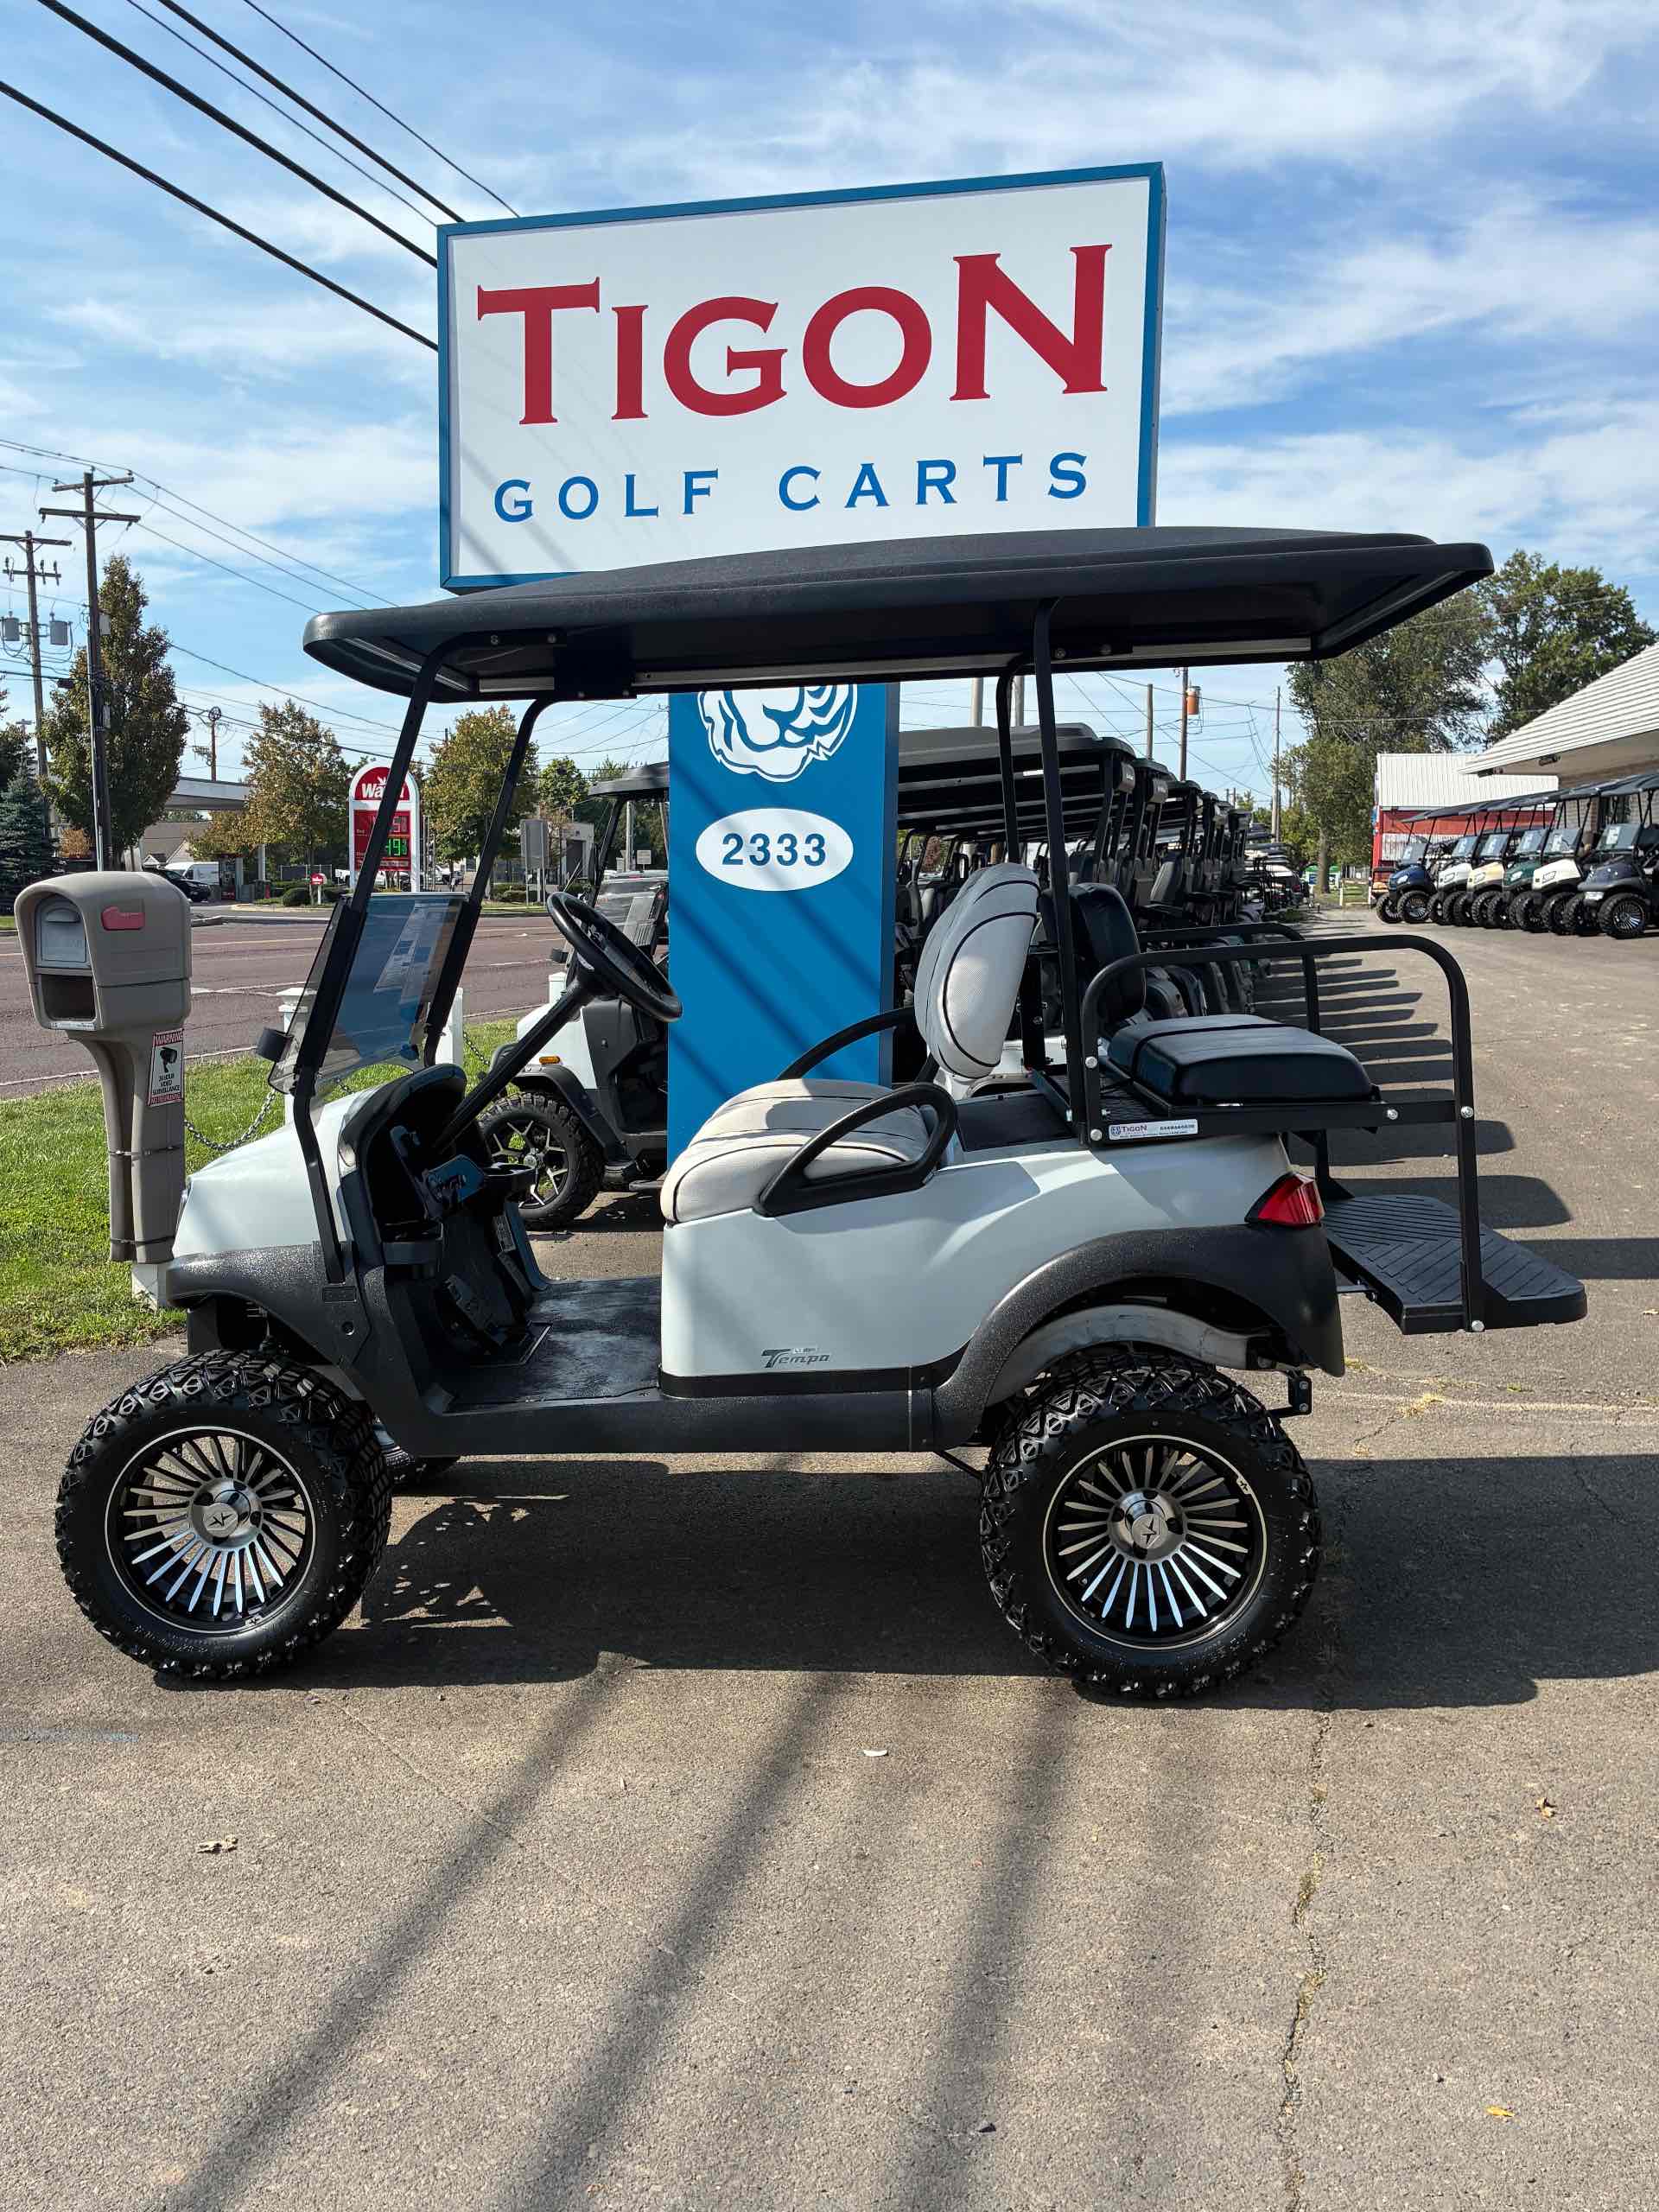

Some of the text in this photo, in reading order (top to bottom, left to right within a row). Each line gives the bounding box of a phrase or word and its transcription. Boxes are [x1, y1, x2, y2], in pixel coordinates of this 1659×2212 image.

[477, 244, 1112, 426] TIGON
[493, 452, 1087, 524] GOLF CARTS
[721, 832, 826, 867] 2333
